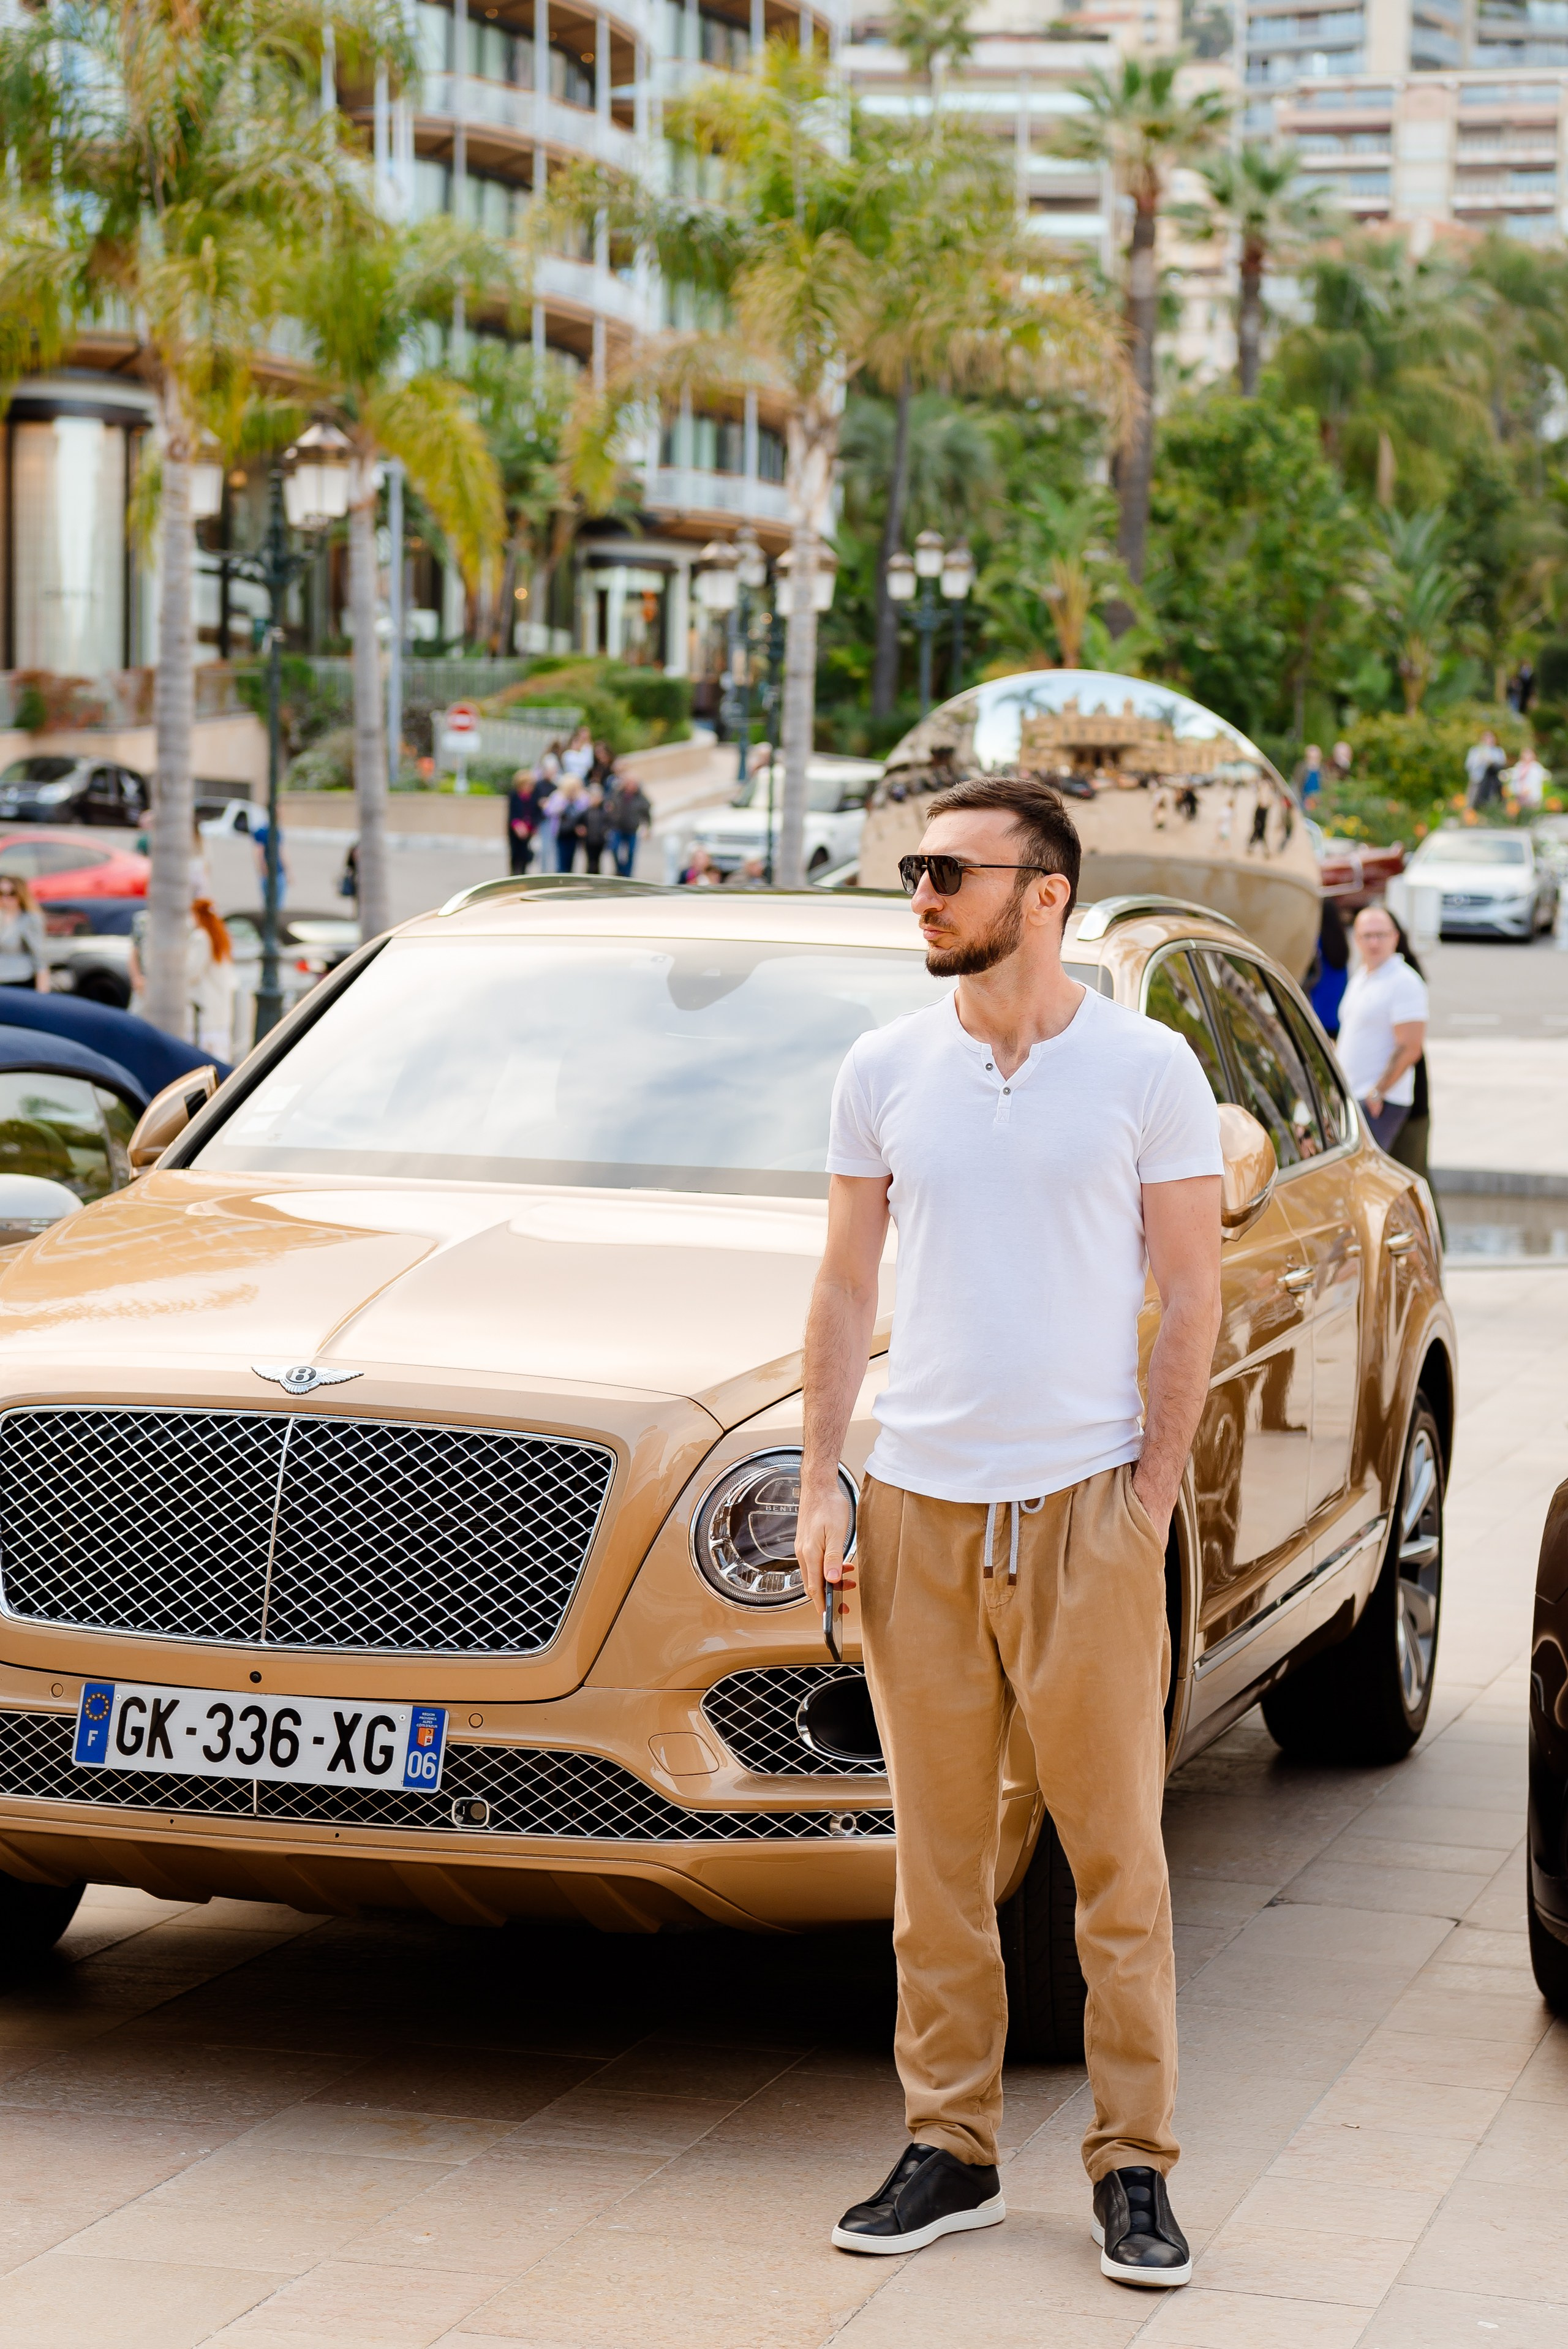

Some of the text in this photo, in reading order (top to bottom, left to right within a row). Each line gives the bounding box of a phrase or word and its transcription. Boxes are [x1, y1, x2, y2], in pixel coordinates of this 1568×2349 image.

[289, 1368, 311, 1382] B
[87, 1730, 99, 1746] F
[115, 1696, 397, 1775] GK-336-XG
[407, 1751, 437, 1779] 06
